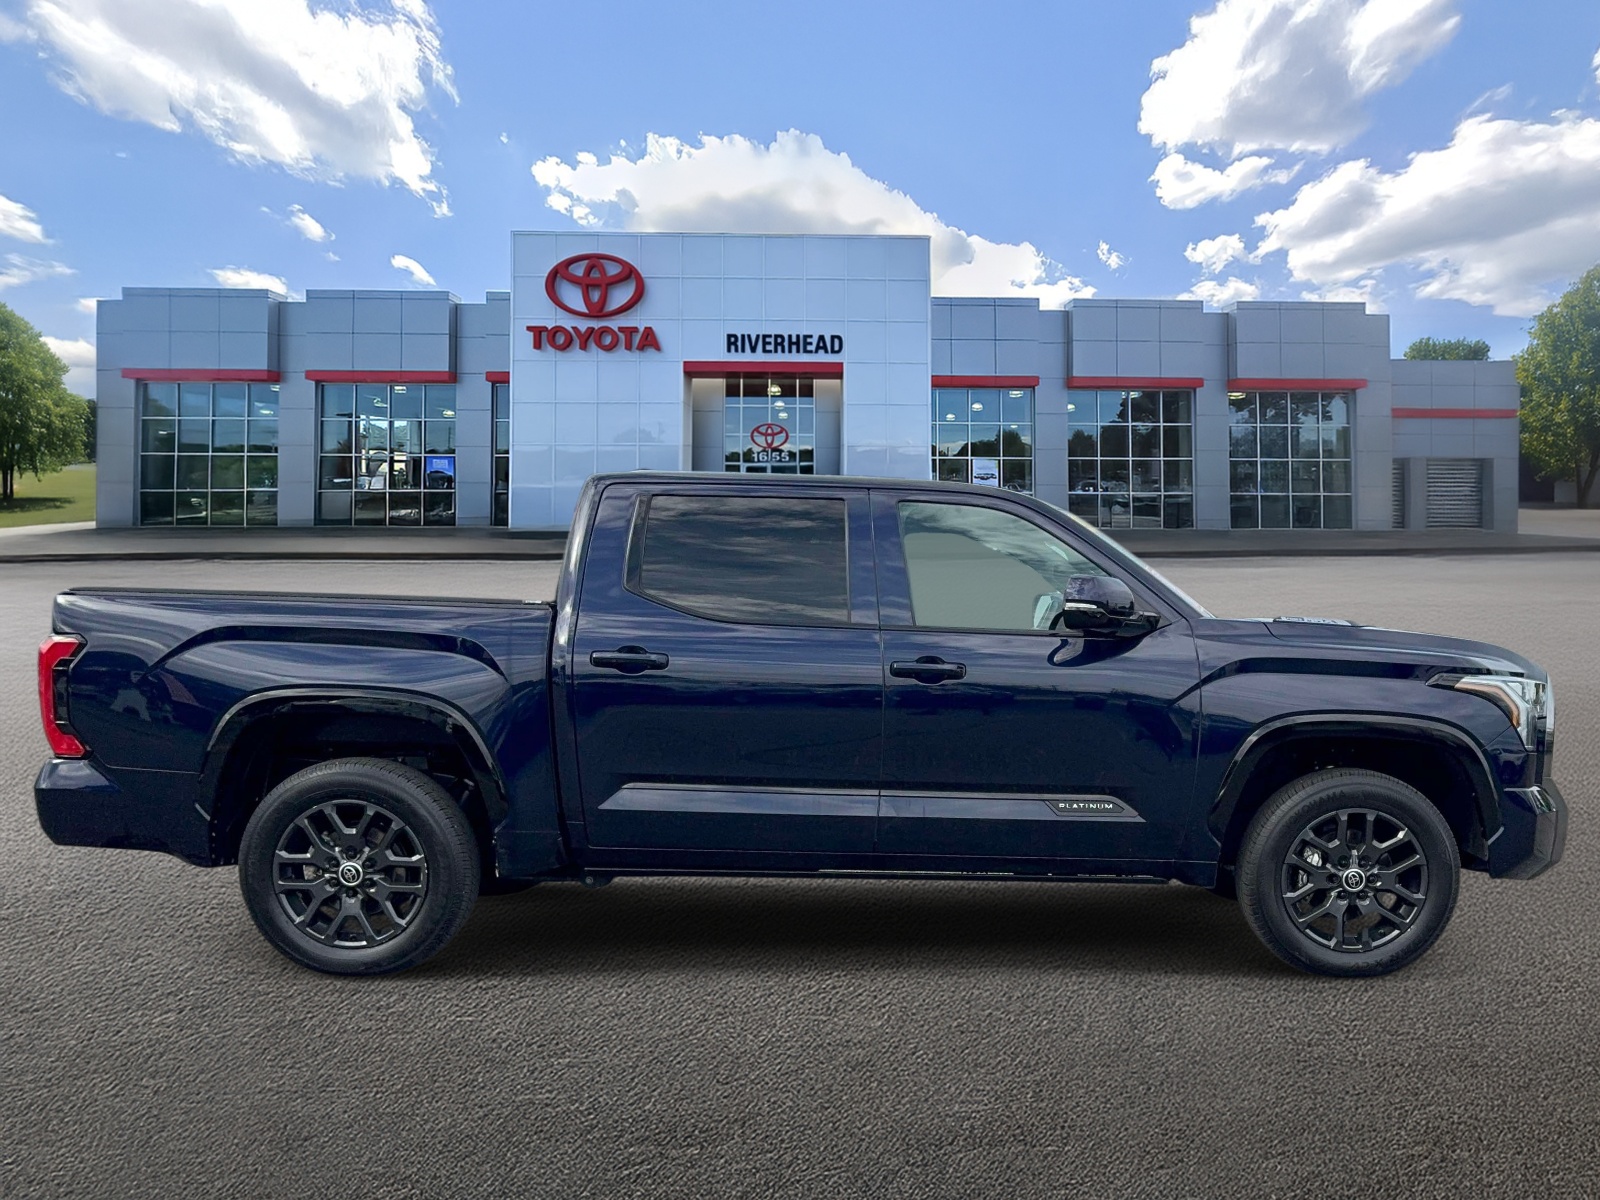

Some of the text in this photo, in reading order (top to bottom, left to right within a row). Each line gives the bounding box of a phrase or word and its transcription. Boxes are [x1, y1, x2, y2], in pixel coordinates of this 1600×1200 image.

[526, 326, 660, 352] TOYOTA
[726, 333, 844, 354] RIVERHEAD
[752, 451, 789, 462] 1655
[1058, 802, 1113, 810] PLATINUM
